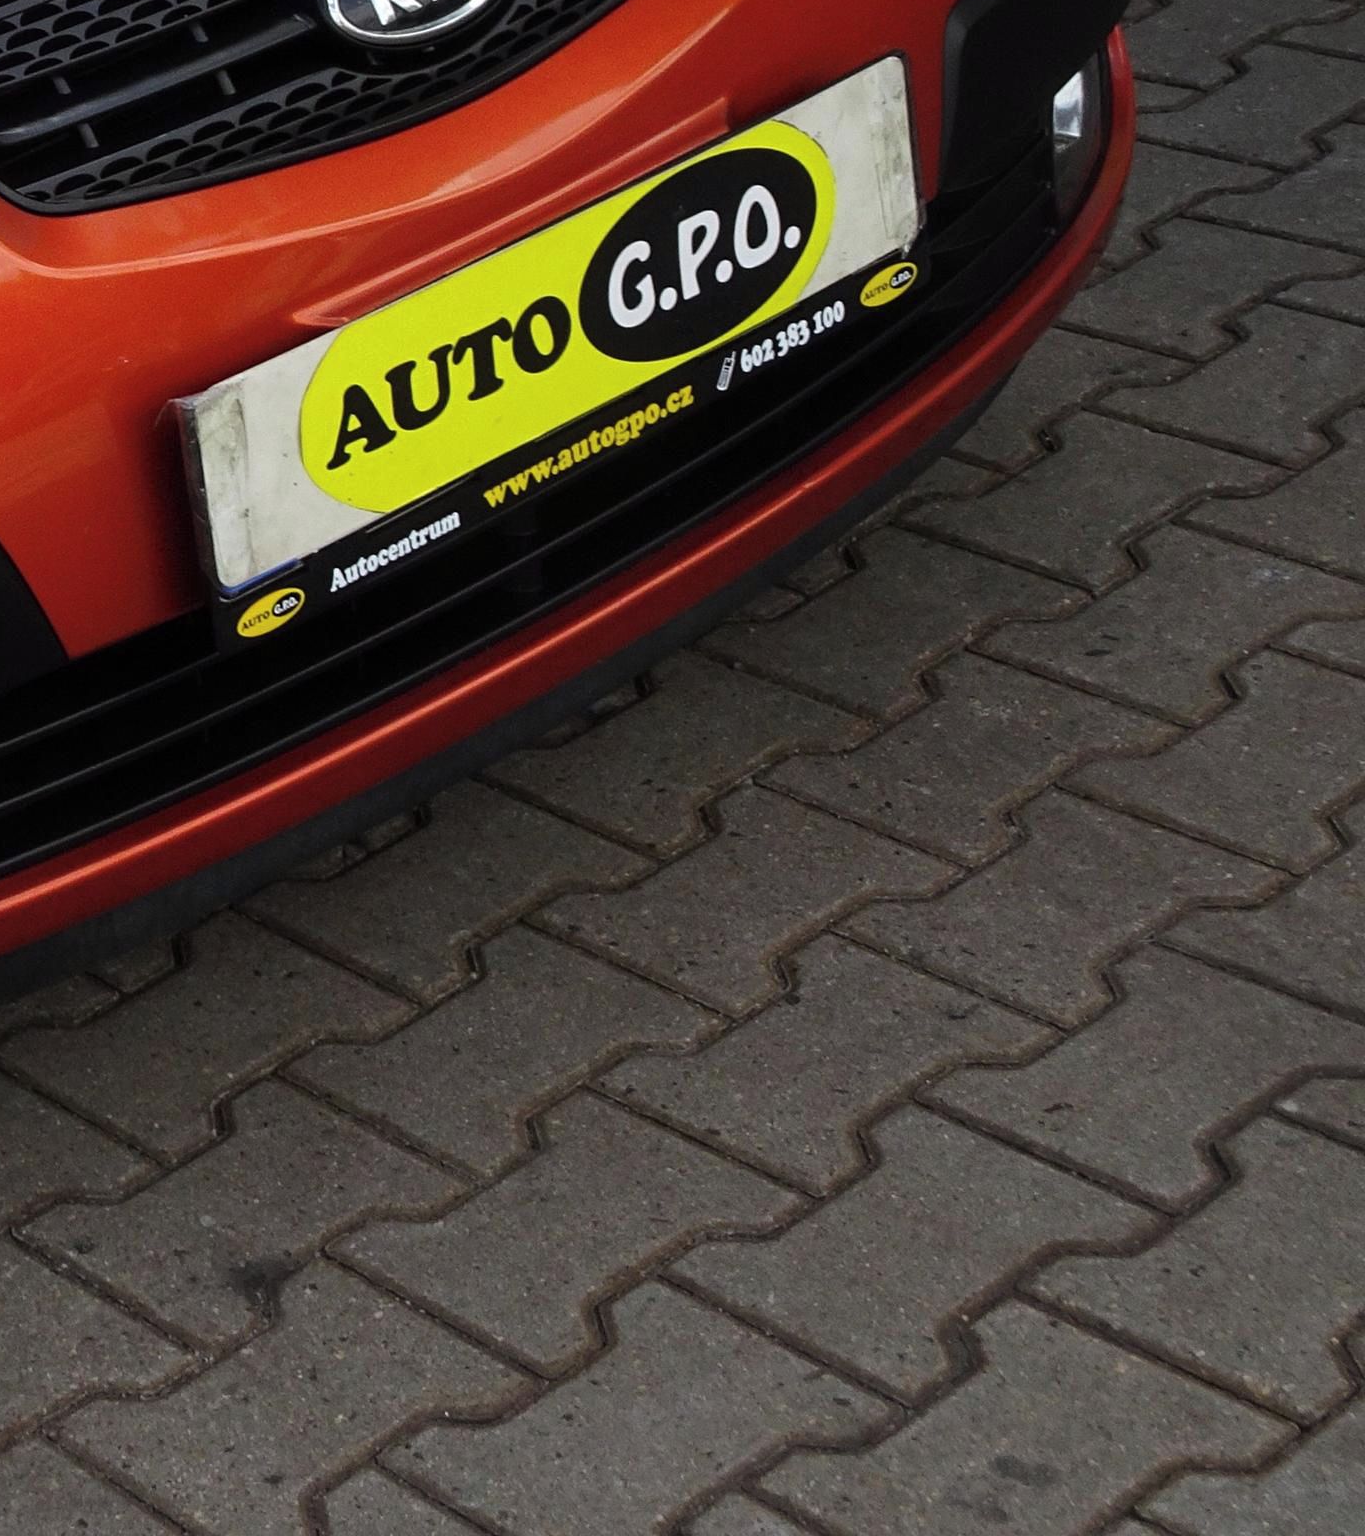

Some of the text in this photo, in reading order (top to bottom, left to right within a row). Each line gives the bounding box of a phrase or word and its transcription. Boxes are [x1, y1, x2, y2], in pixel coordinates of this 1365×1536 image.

[326, 184, 801, 471] AUTO G.P.O.
[330, 300, 846, 592] Autocentrum www.autogpo.cz 602 383 100
[242, 611, 270, 633] AUTO
